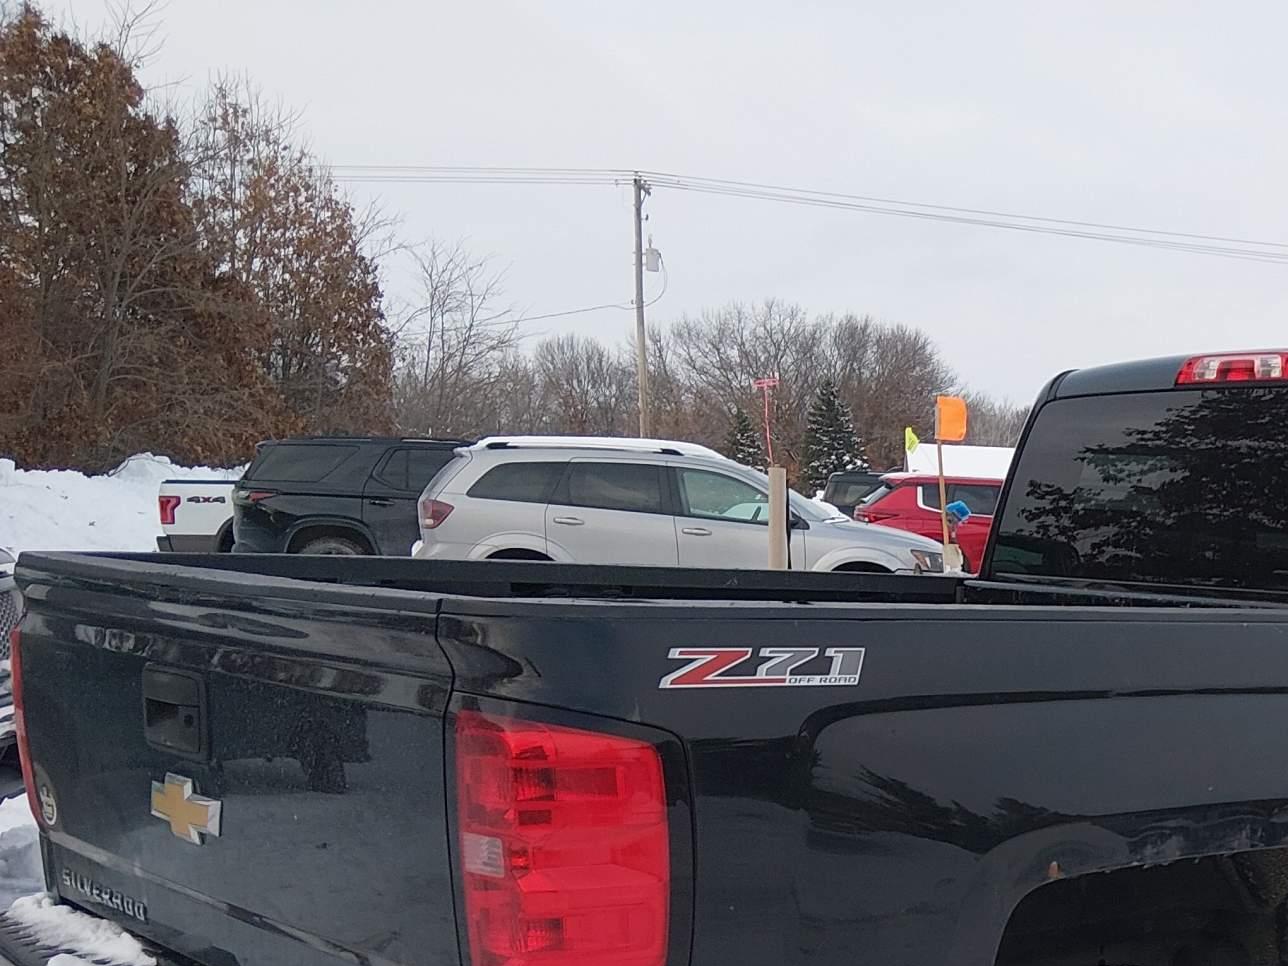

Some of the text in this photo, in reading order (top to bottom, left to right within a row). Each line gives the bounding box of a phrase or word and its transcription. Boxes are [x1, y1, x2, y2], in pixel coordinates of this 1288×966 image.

[658, 647, 866, 689] Z71
[787, 675, 858, 686] OFF ROAD
[62, 867, 147, 922] SILVERADO
